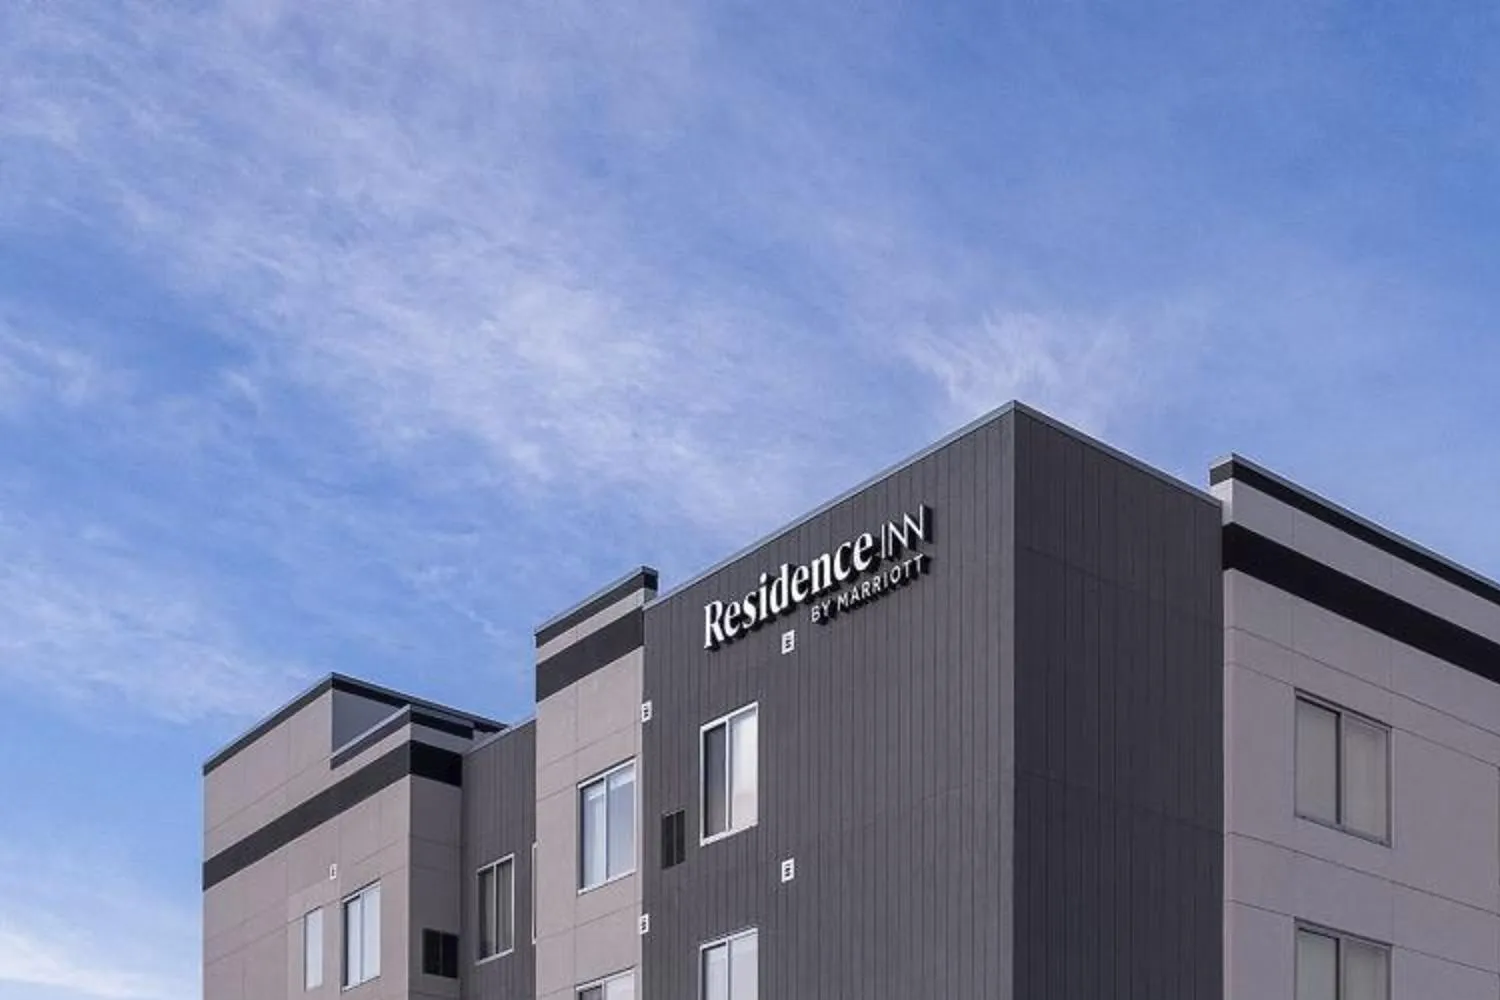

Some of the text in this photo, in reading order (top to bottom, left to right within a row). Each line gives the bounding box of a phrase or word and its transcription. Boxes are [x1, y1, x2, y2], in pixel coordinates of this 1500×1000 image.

[703, 503, 924, 649] Residence INN
[811, 553, 924, 623] BY MARRIOTT
